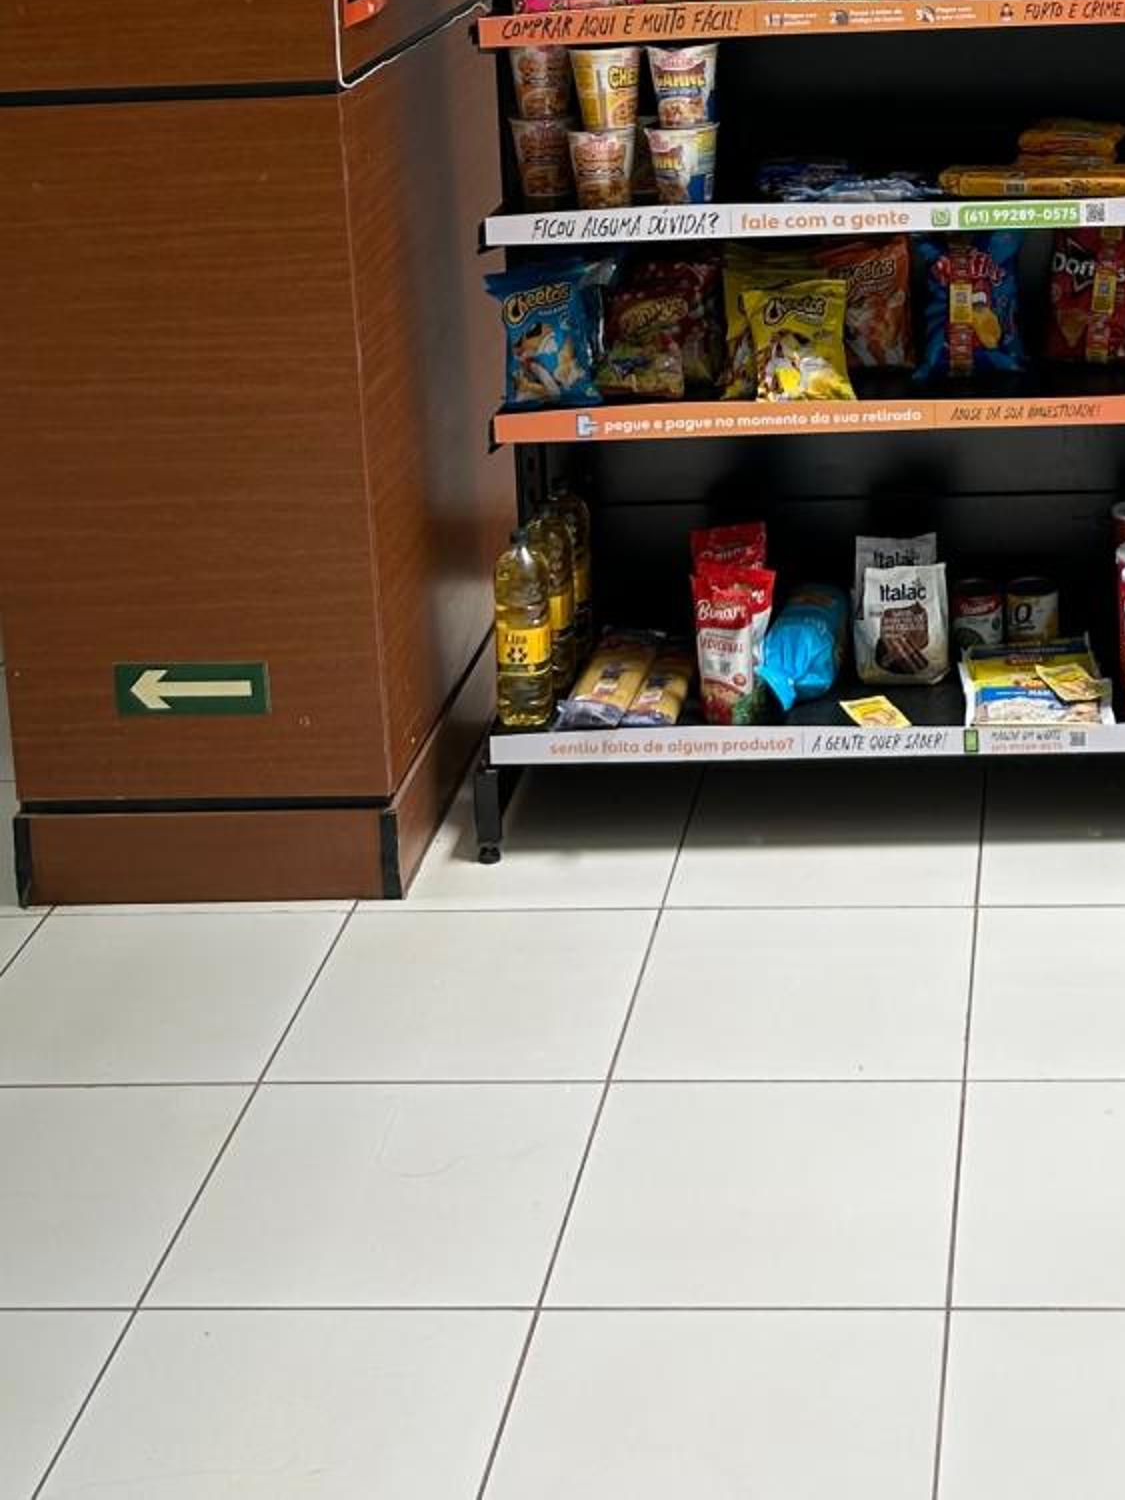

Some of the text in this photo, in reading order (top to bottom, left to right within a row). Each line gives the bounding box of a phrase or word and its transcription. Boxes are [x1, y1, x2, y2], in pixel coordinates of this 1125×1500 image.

[501, 14, 574, 40] COMPRAR
[577, 13, 617, 36] AQUI
[623, 10, 634, 34] É
[640, 6, 687, 35] MUITO
[691, 3, 743, 32] FÁCIL!
[1023, 1, 1063, 21] FURTO
[532, 206, 1078, 240] FICOU ALGUMA DÚVIDA? fale com a gente (61) 99289-0575
[503, 282, 571, 325] Cheetos
[604, 419, 650, 435] pegue
[653, 419, 663, 432] e
[665, 417, 713, 432] pague
[715, 416, 735, 428] no
[737, 414, 807, 427] momento
[810, 412, 830, 426] da
[832, 411, 858, 425] sua
[862, 409, 922, 423] retirada
[880, 581, 927, 602] Italac
[550, 732, 948, 756] sentiu falta de algum produto? A GENTE QUER SABER!
